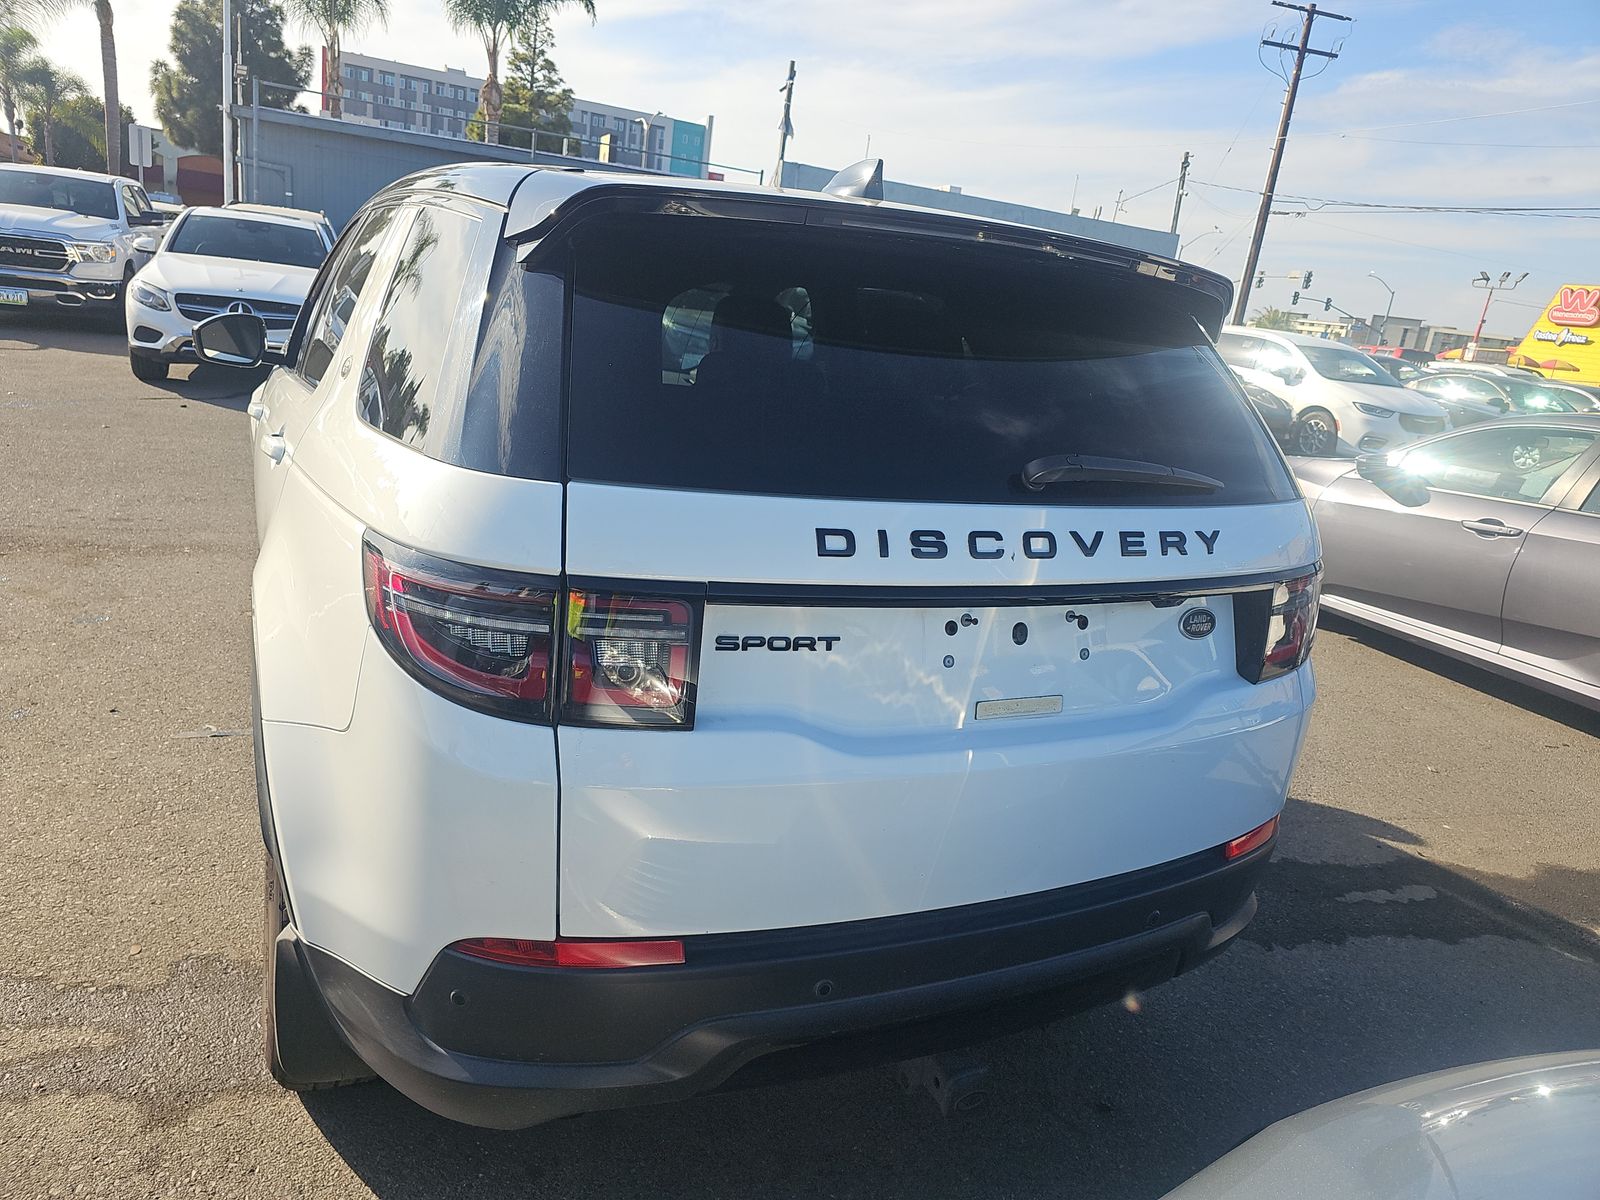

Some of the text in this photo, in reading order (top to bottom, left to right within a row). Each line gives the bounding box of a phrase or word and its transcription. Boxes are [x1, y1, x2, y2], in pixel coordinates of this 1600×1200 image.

[0, 246, 32, 255] AM
[1561, 287, 1600, 312] W
[815, 527, 1221, 560] DISCOVERY
[1190, 614, 1207, 624] LAND
[1190, 623, 1212, 632] ROVER
[714, 635, 841, 652] SPORT
